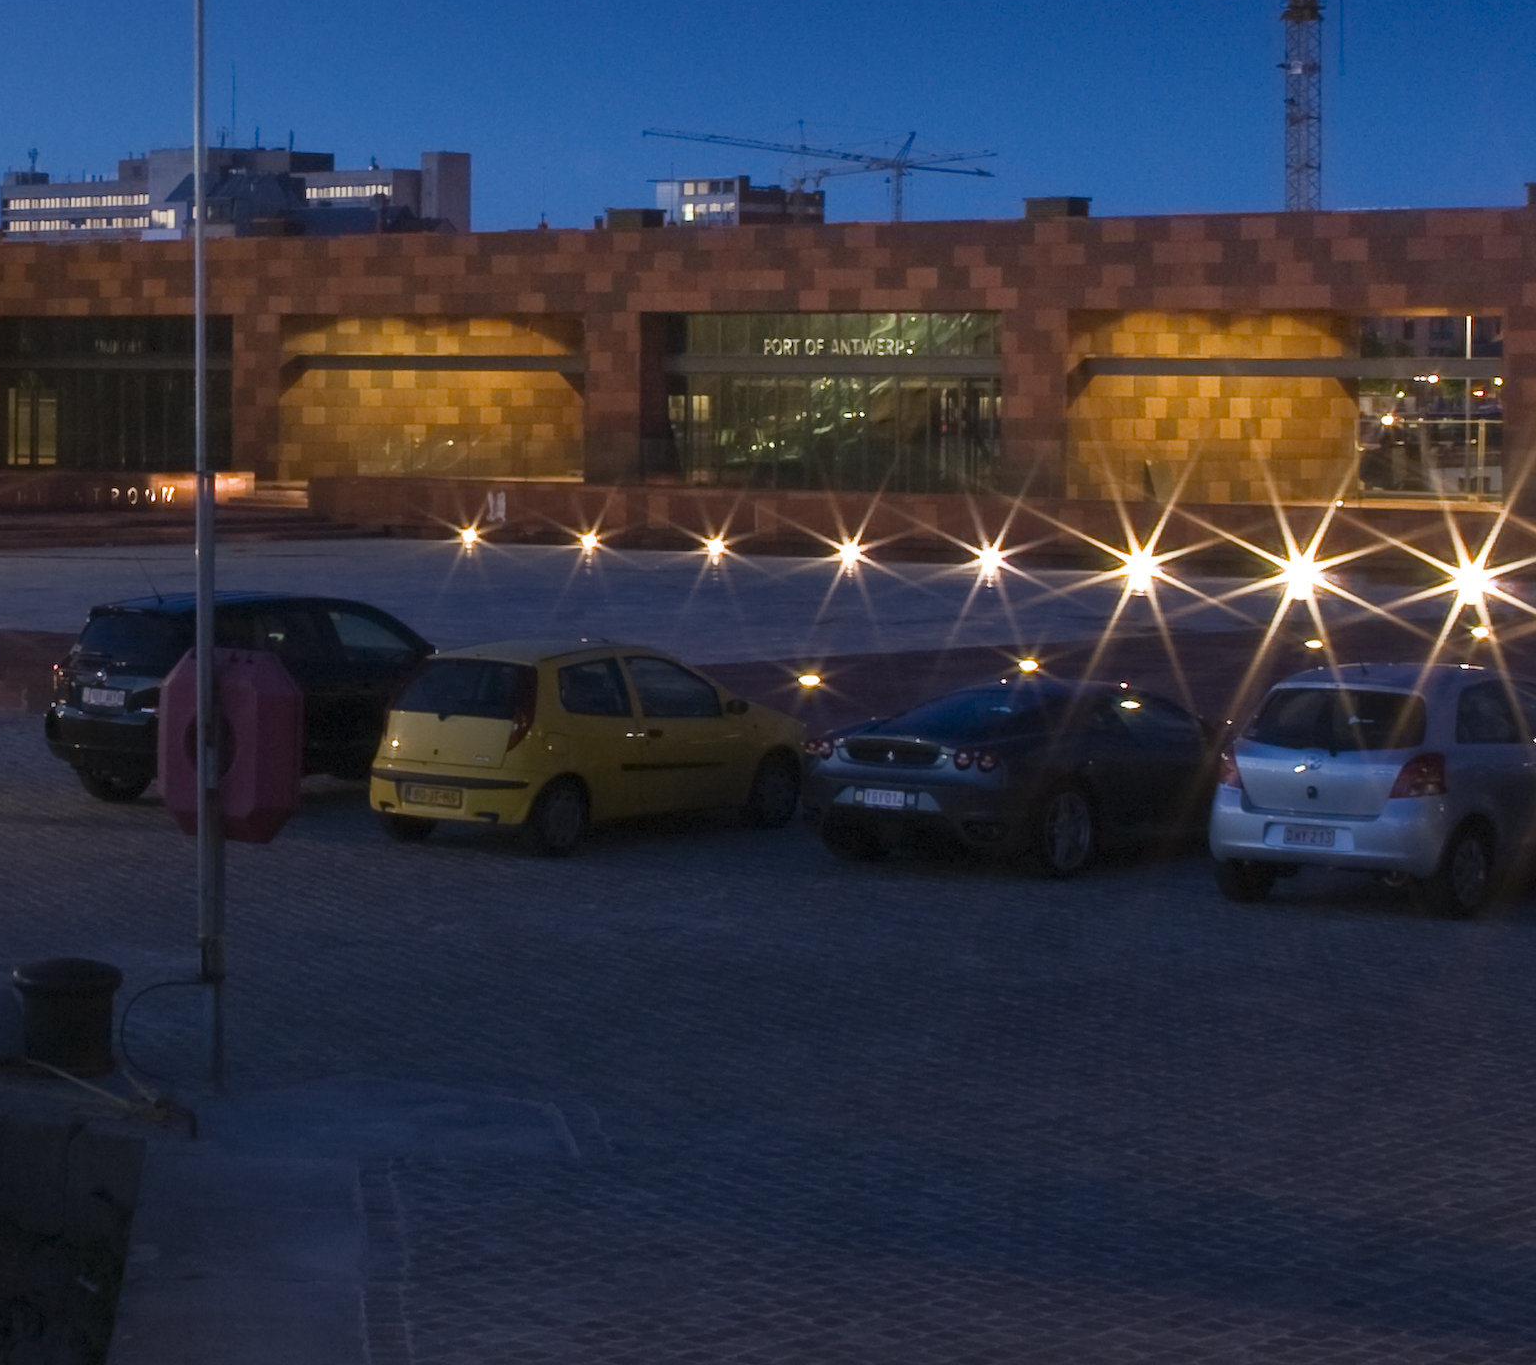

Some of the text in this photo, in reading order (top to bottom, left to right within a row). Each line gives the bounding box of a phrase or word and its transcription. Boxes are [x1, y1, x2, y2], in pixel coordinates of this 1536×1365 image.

[763, 338, 905, 356] PORT OF ANTWERP
